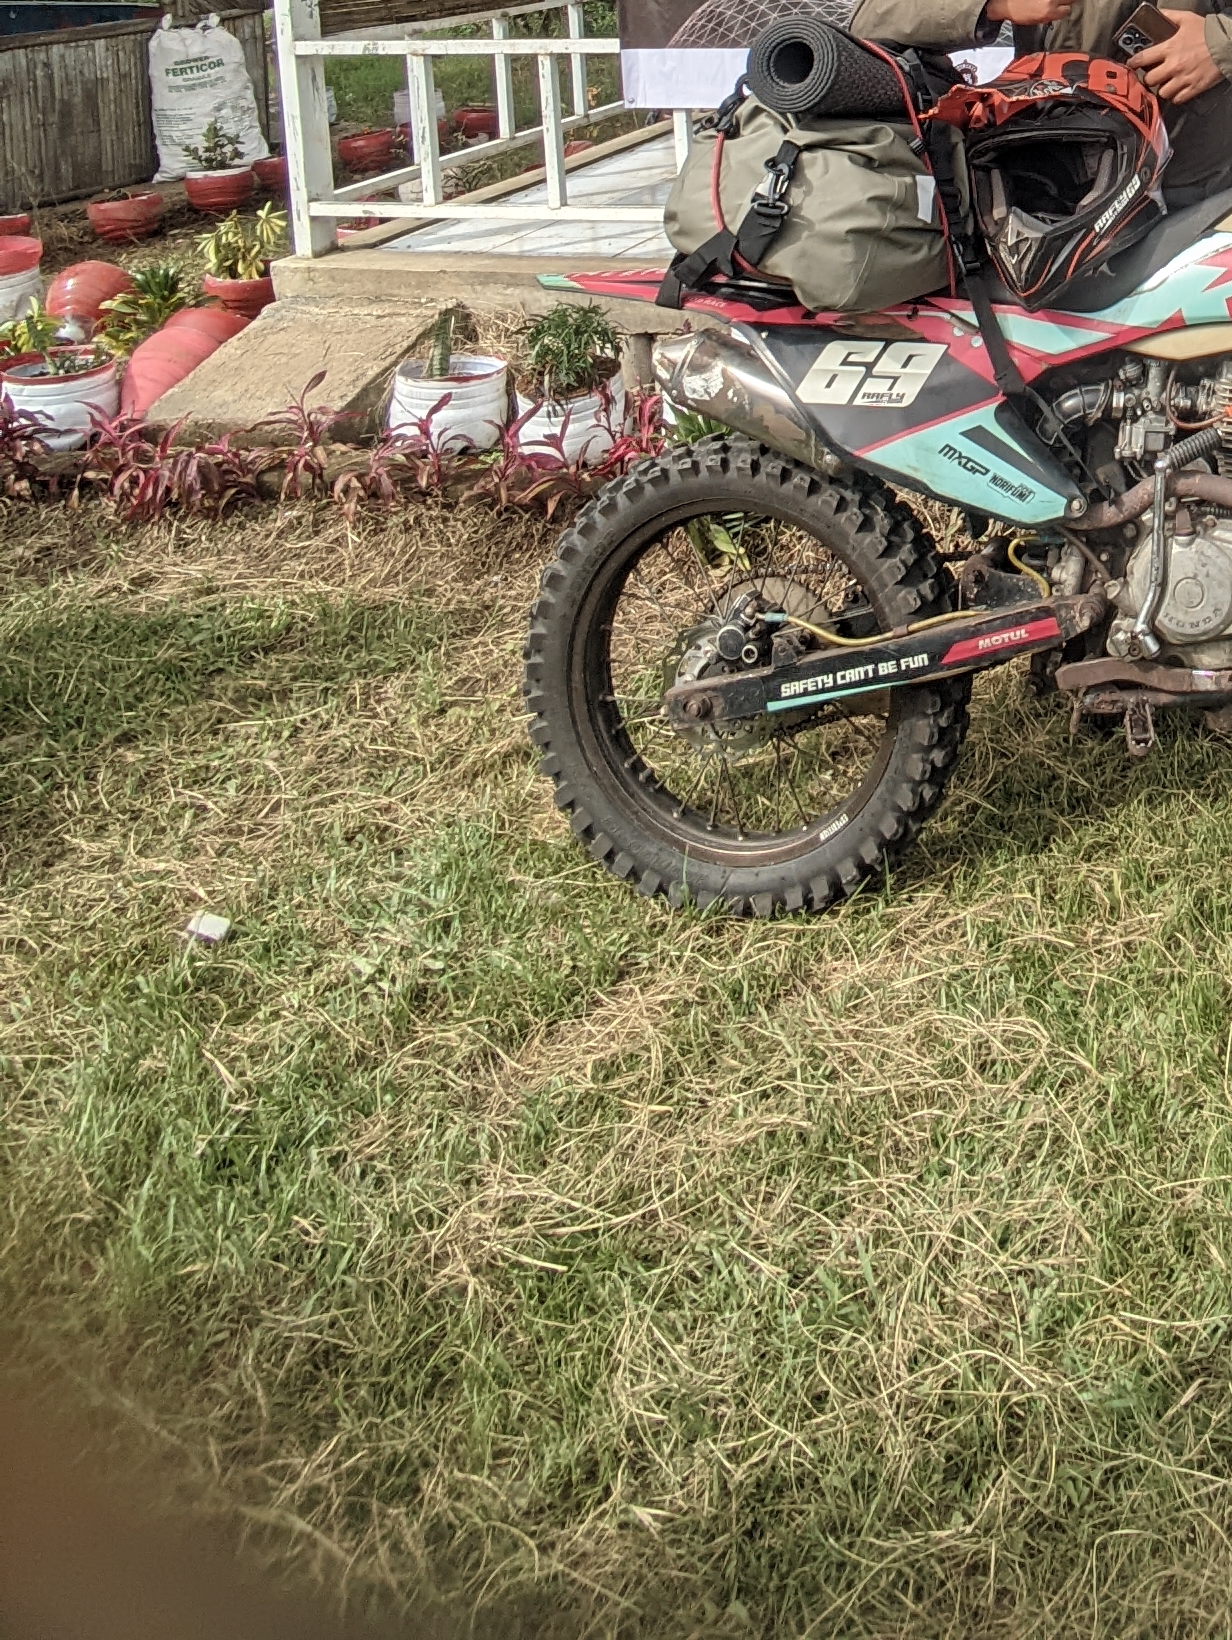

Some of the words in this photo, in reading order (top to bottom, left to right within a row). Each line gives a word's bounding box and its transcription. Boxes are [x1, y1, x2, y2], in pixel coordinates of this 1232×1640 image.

[795, 340, 949, 407] 69
[937, 442, 991, 477] MXGP
[1163, 607, 1223, 629] HONDA
[978, 628, 1029, 650] MOTUL
[780, 671, 834, 698] SAFETY
[878, 659, 899, 675] BE
[901, 653, 930, 671] FUN
